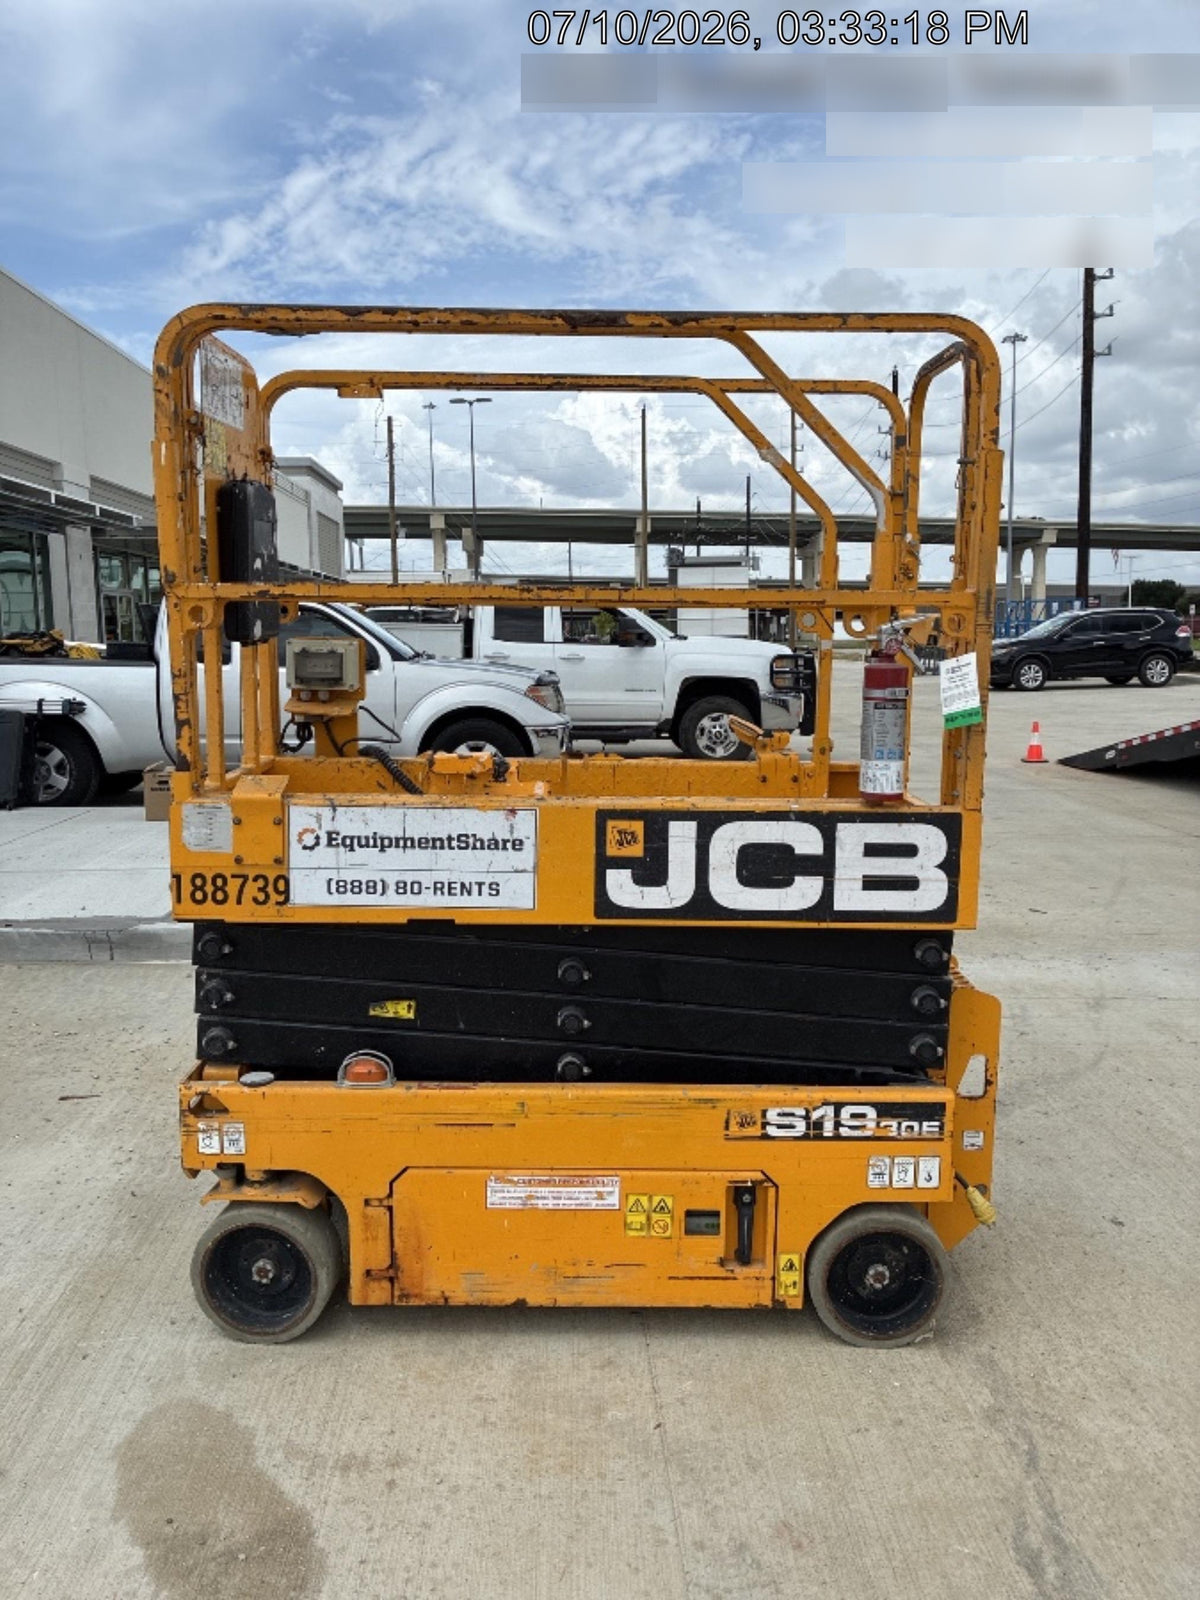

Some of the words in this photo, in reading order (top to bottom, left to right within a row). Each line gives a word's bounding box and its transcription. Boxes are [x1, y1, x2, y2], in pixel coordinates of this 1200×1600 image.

[325, 831, 525, 853] EquipmentShare
[605, 820, 948, 912] JCB
[172, 873, 290, 906] 188739
[326, 878, 387, 897] (888)
[395, 879, 501, 898] 80-RENTS
